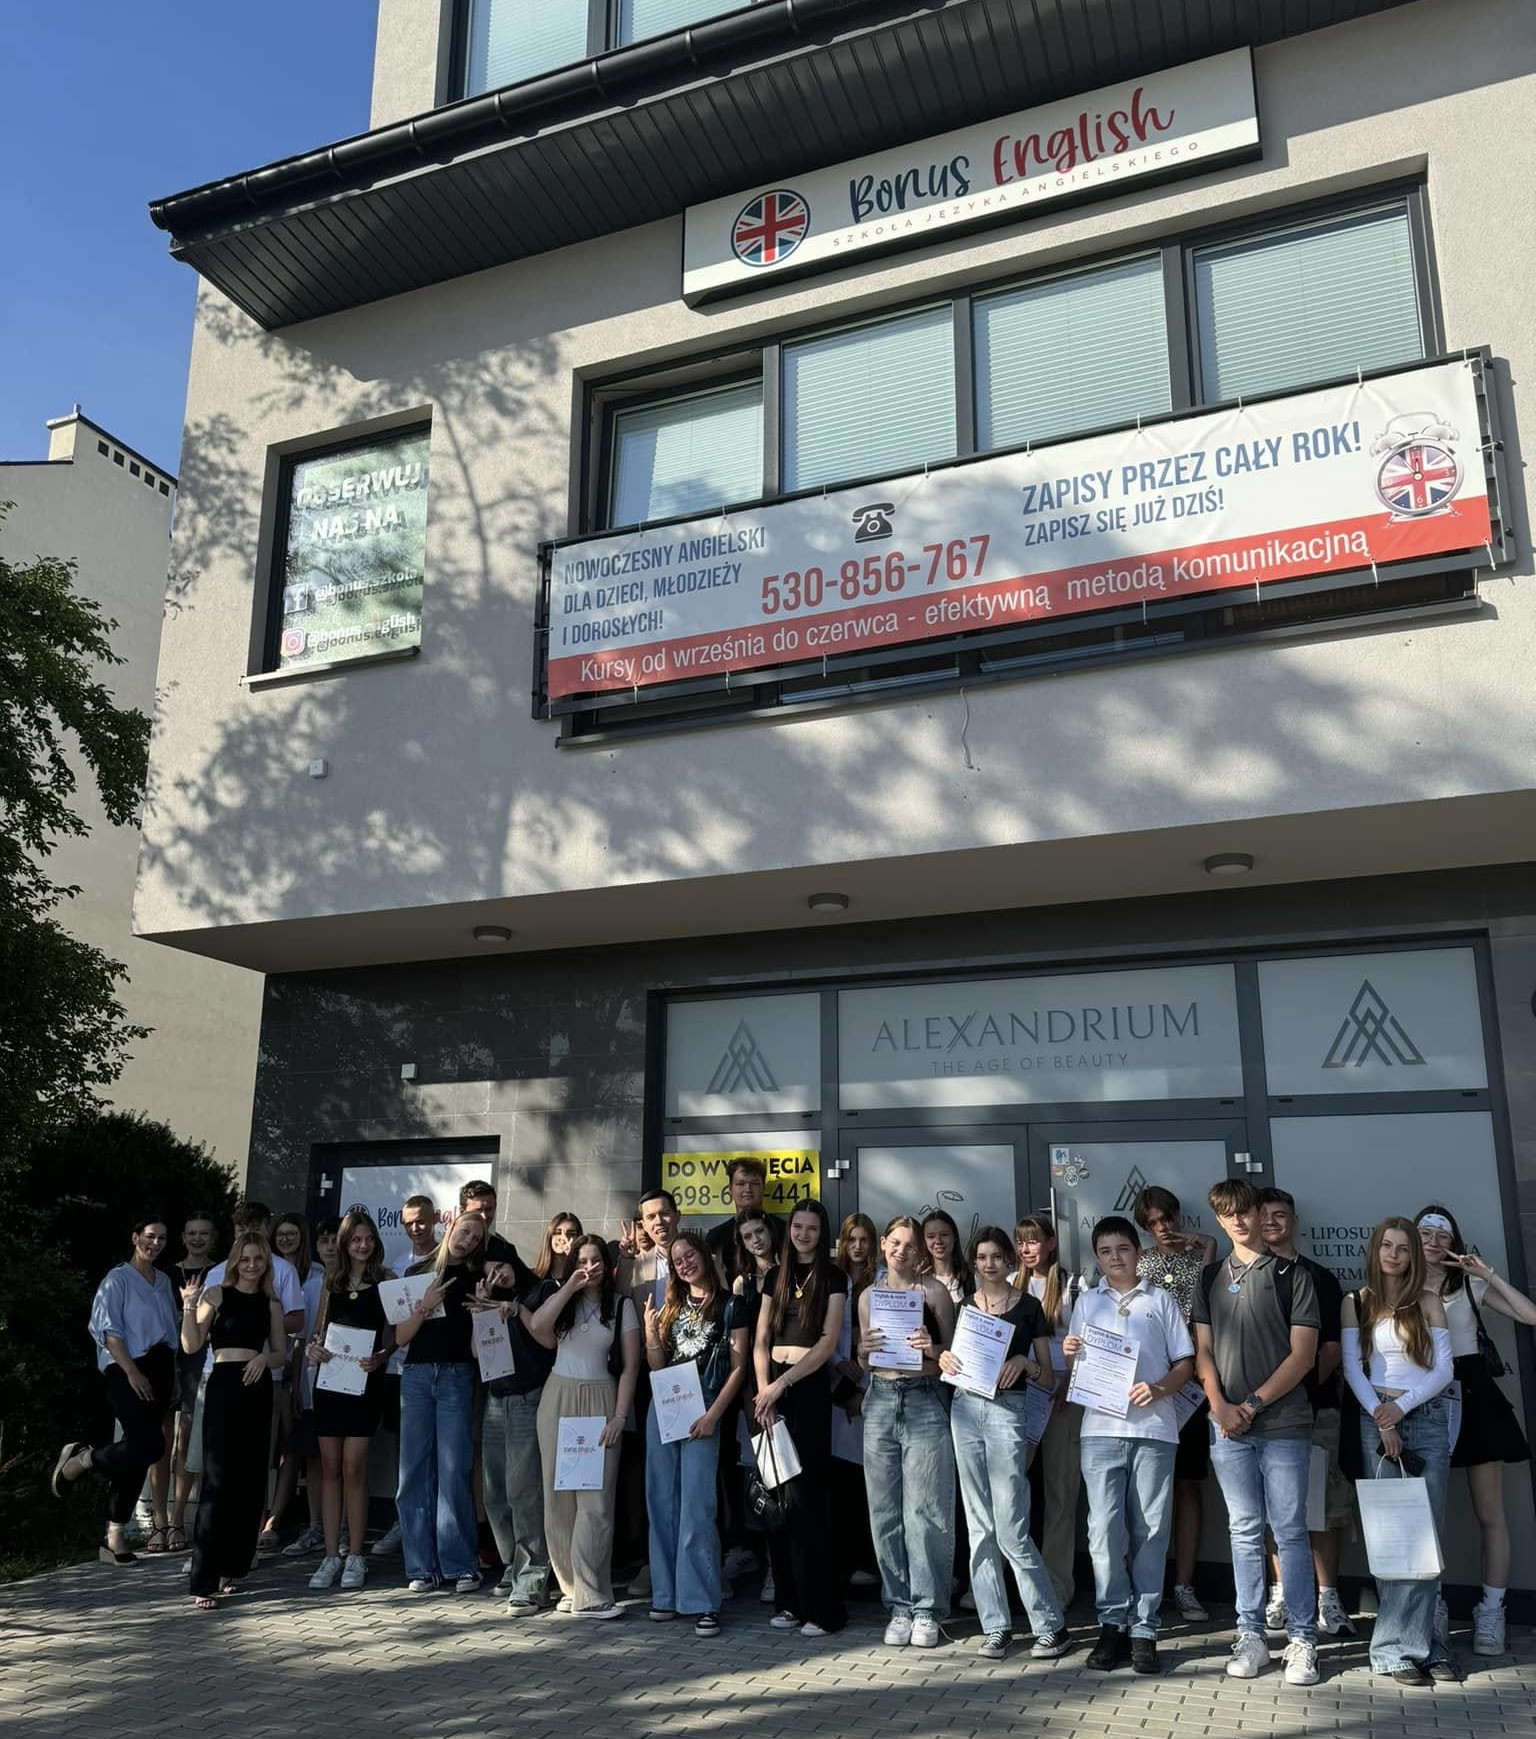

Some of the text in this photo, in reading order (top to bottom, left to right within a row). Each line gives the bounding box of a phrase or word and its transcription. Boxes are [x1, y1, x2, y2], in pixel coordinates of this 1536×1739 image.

[850, 87, 1175, 224] Bonus English
[833, 141, 1199, 247] SZKOŁA JĘZYKA ANGIELSKIEGO
[1022, 421, 1362, 515] ZAPISY PRZEZ CAŁY ROK!
[312, 504, 401, 540] NAS NA
[1024, 489, 1225, 546] ZAPISZ SIĘ JUŻ DZIŚ!
[565, 526, 765, 585] NOWOCZESNY ANGIELSKI
[761, 534, 991, 615] 530-856-767
[564, 562, 742, 615] DLA DZIECI, MŁODZIEŻY
[581, 656, 636, 682] Kursy
[642, 648, 666, 672] od
[673, 632, 766, 669] września
[773, 626, 799, 652] do
[806, 610, 899, 646] czerwca
[925, 582, 1050, 625] efektywną
[1067, 563, 1167, 601] metodą
[1172, 529, 1370, 583] komunikacjną
[562, 609, 664, 646] I DOROSŁYCH!
[872, 1002, 1201, 1054] ALEXANDRIUM
[931, 1052, 1129, 1074] THE AGE OF BEAUTY
[668, 1156, 815, 1179] DO WYĘCIA
[672, 1182, 812, 1206] 698-6-441
[1311, 1227, 1372, 1240] LIPOSU
[1313, 1244, 1367, 1257] ULTRA
